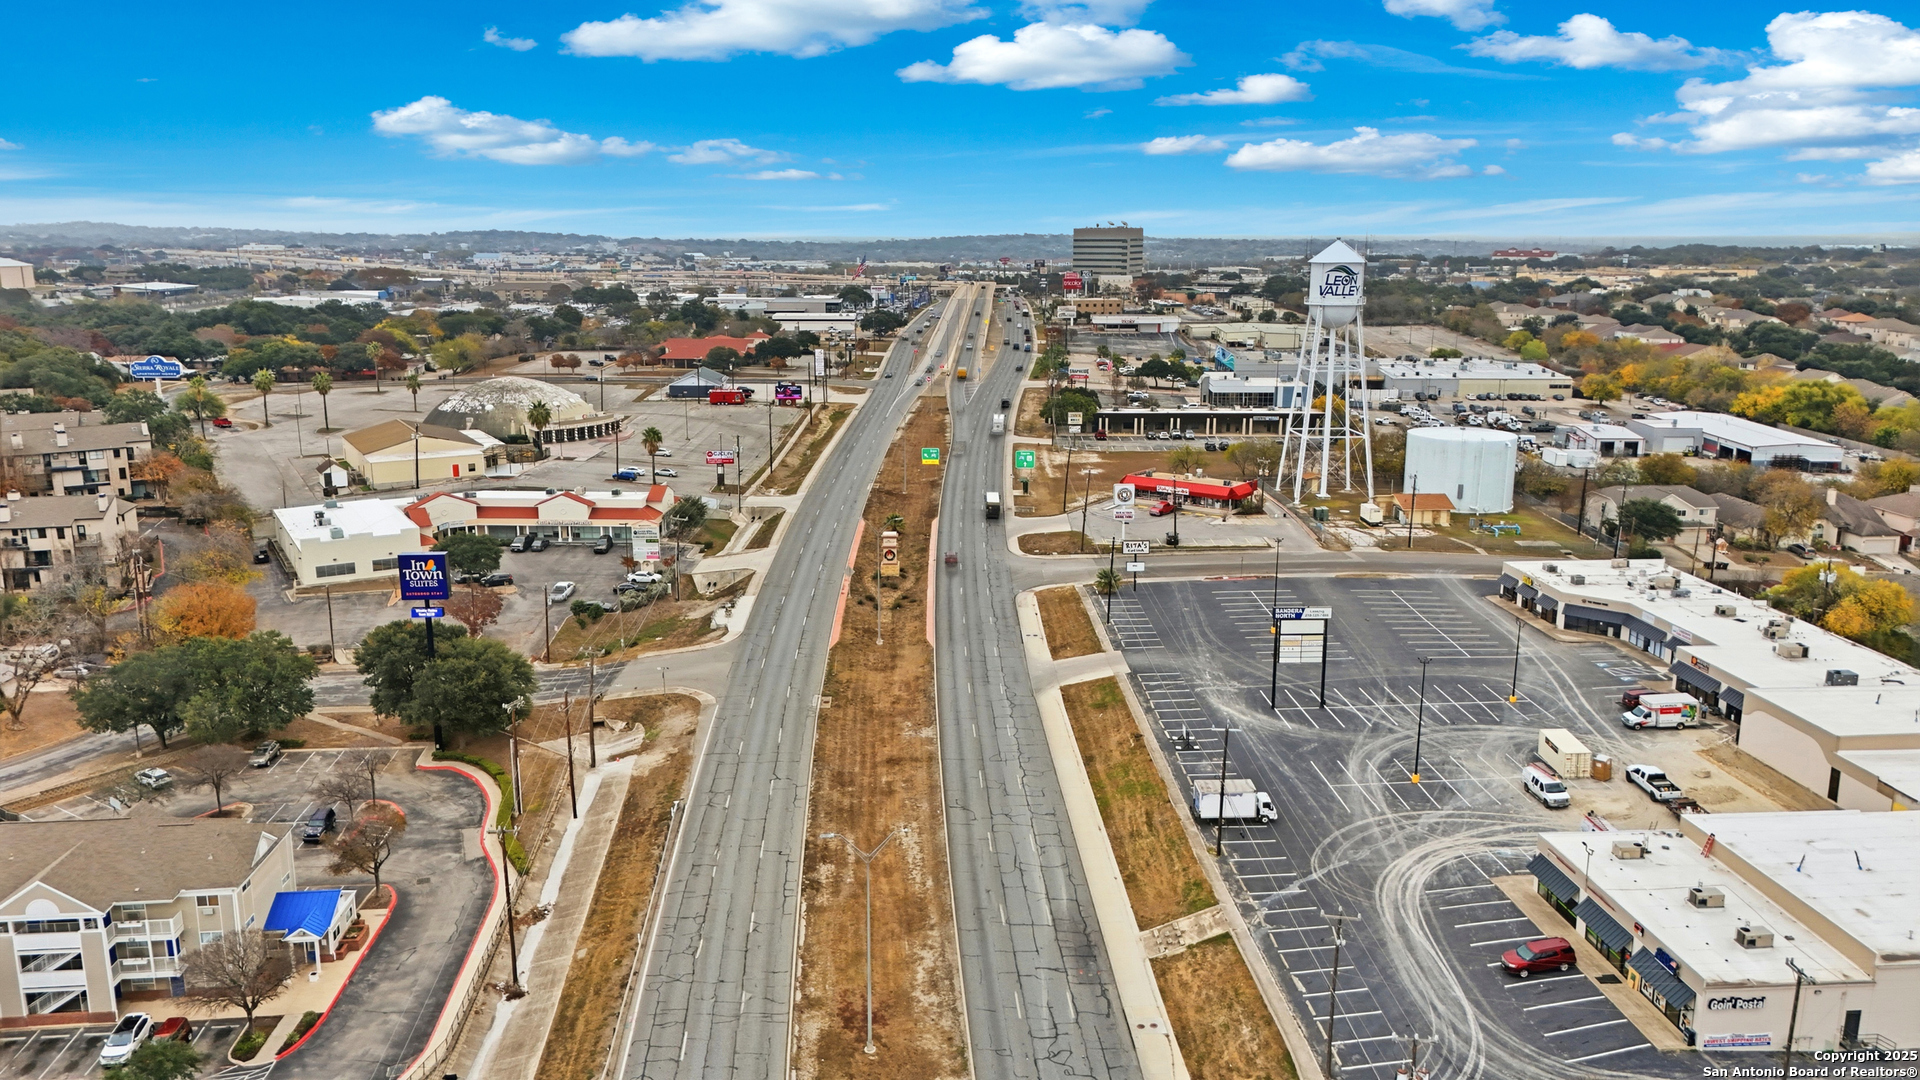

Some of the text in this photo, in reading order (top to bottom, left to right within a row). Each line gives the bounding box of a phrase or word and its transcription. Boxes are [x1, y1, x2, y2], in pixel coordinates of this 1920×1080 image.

[1325, 273, 1358, 286] LEON
[1319, 285, 1361, 297] VALLEY
[1125, 541, 1148, 549] RITA'S
[410, 559, 426, 571] In
[402, 569, 444, 581] Town
[409, 580, 439, 588] SUITES
[1709, 997, 1735, 1011] Goin'
